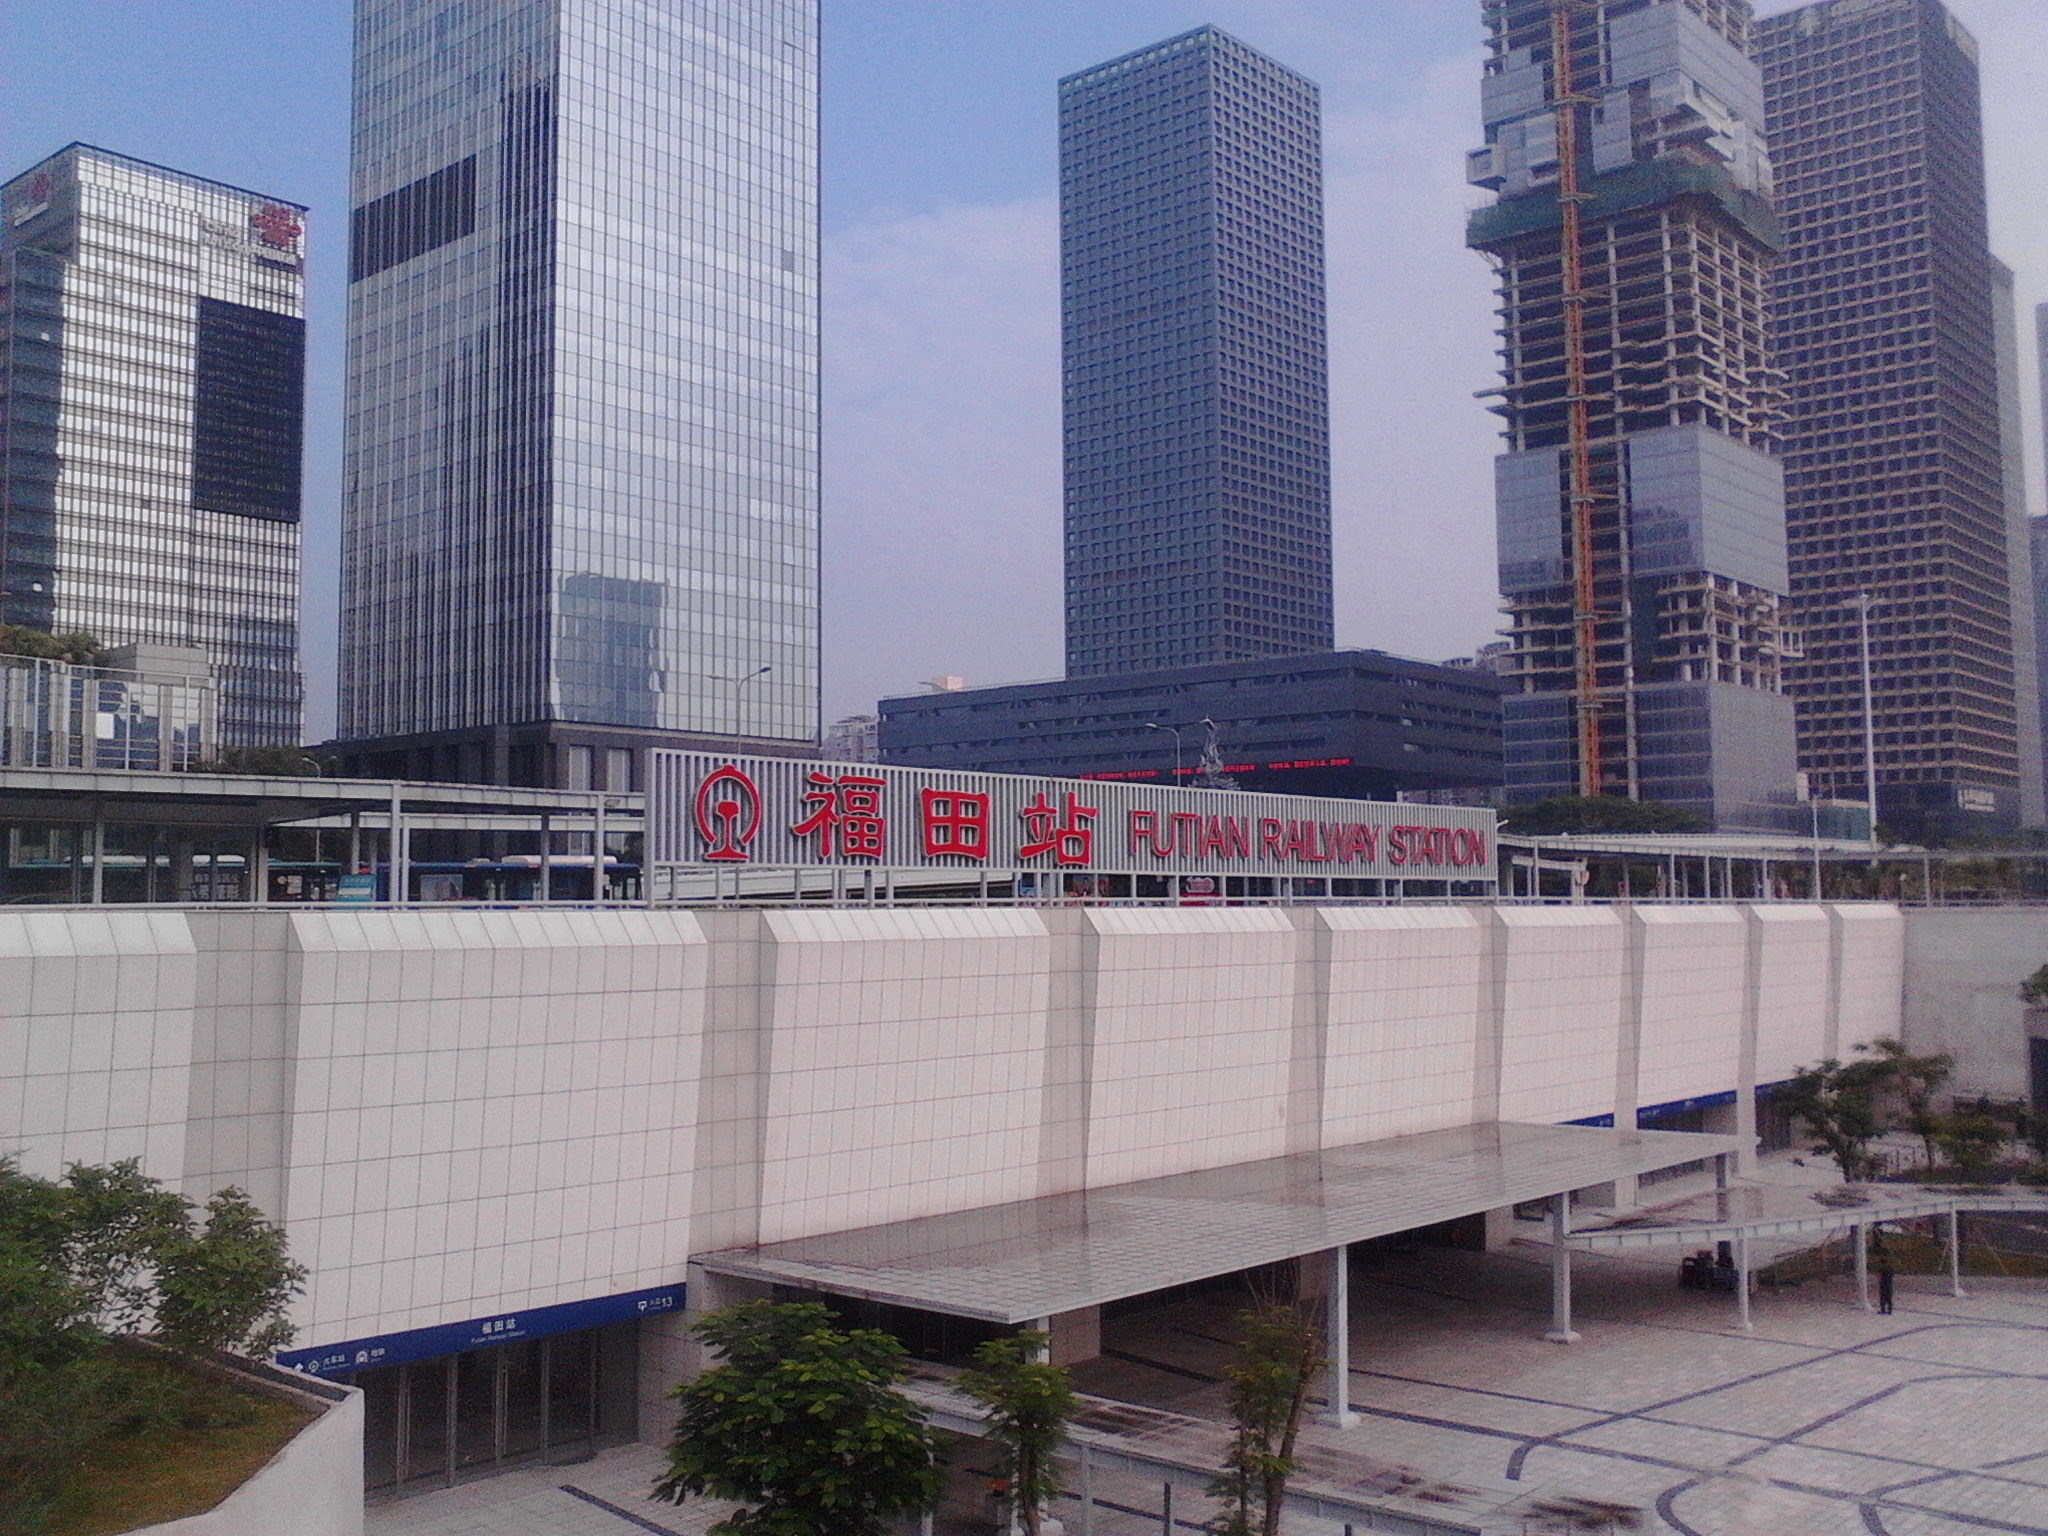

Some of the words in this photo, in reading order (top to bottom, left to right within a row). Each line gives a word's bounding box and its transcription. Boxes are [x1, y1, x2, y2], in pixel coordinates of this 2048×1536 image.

[792, 771, 1097, 865] 福田站
[1129, 810, 1250, 859] FUTIAN
[1259, 817, 1380, 864] RAILWAY
[1388, 824, 1488, 867] STATION
